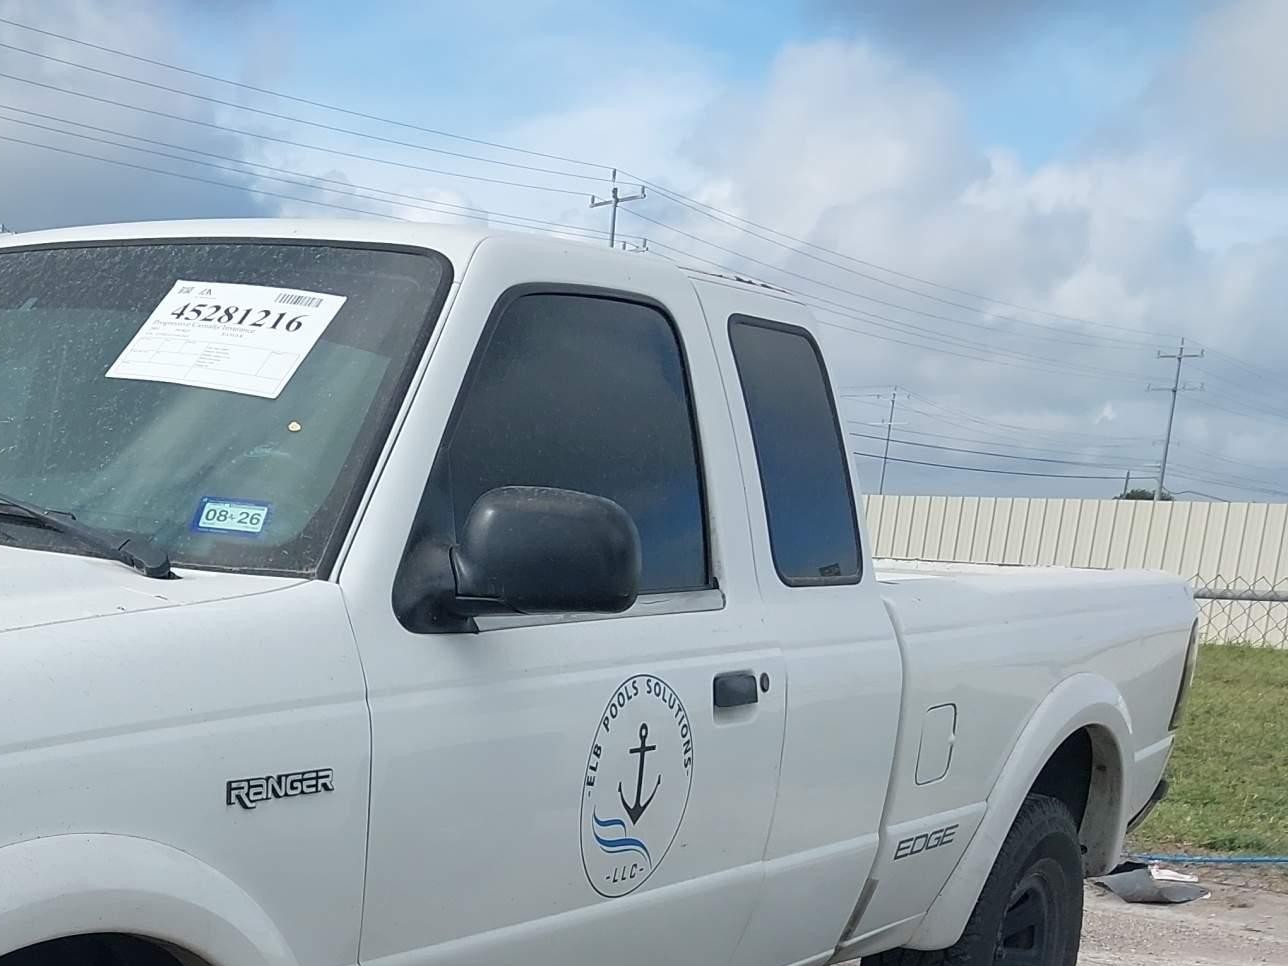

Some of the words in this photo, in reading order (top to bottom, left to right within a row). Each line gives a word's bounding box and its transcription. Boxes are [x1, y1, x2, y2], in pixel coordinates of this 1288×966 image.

[171, 302, 312, 332] 45281216
[205, 508, 229, 523] 08
[237, 511, 262, 526] 26
[603, 680, 638, 732] POOLS
[226, 767, 334, 810] RANGER
[893, 823, 960, 860] EDGE
